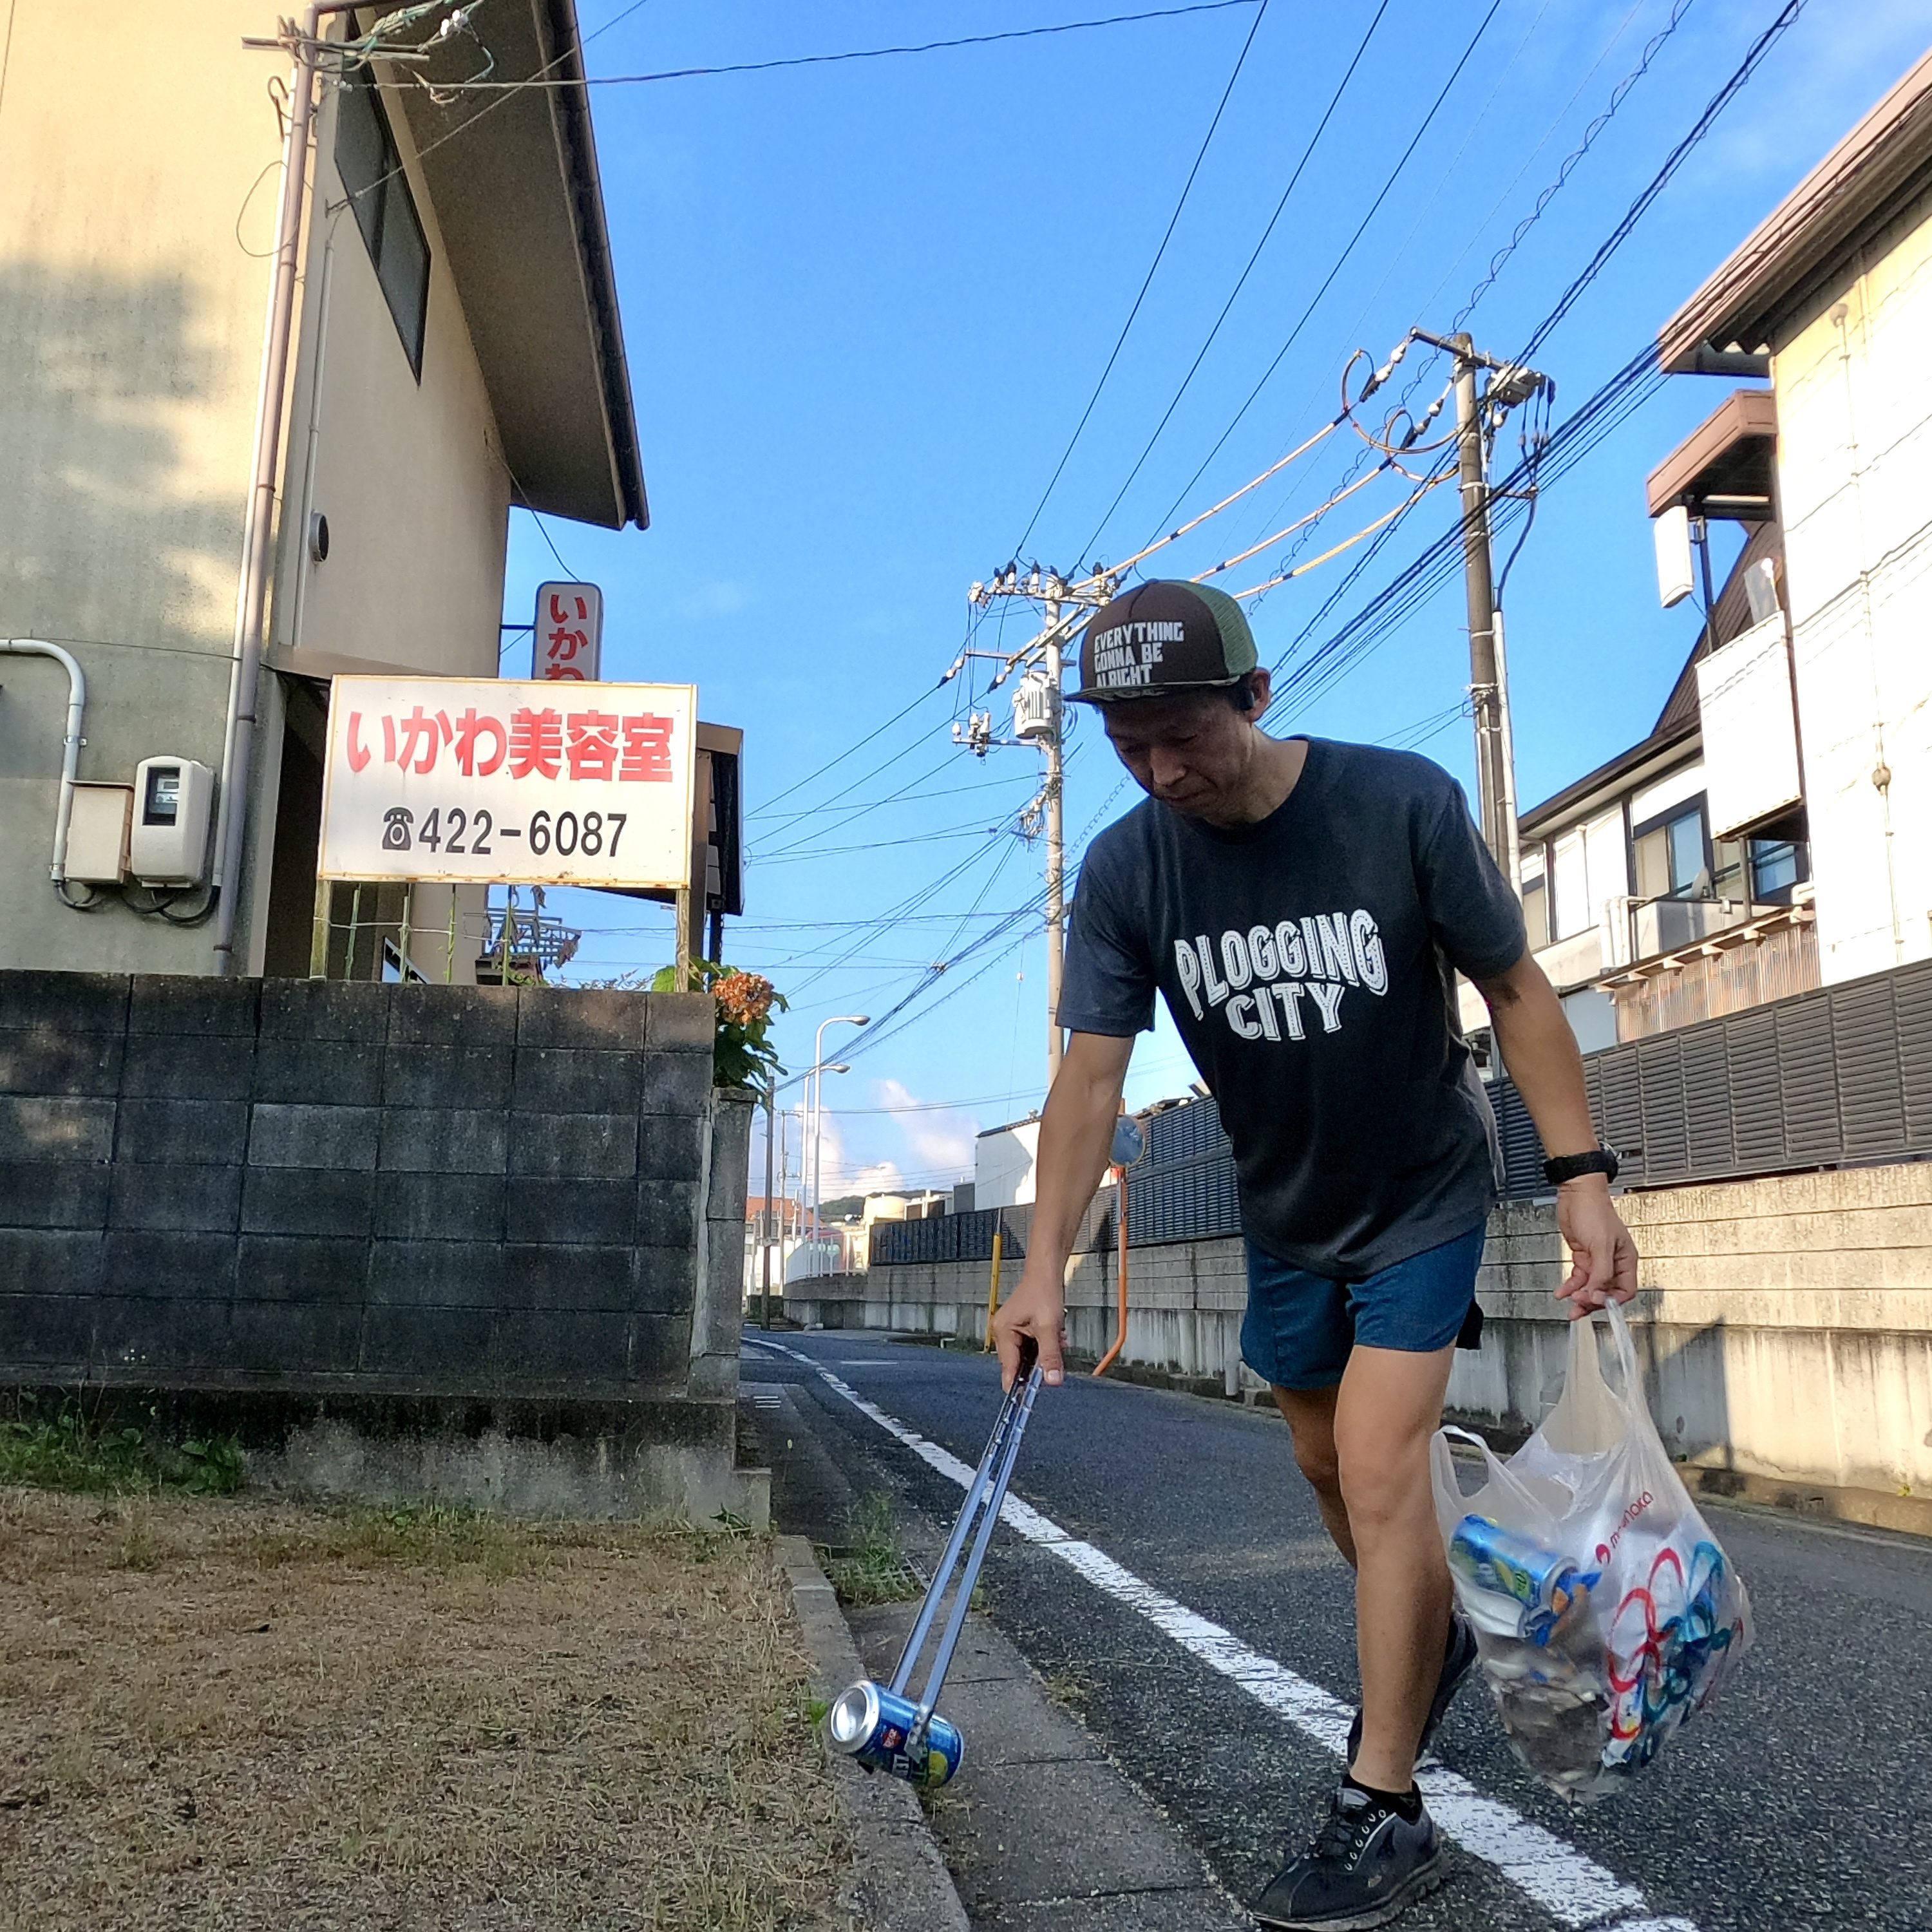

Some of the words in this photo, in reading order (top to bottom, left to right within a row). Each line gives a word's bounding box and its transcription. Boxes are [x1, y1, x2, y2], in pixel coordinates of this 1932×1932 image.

[1095, 621, 1184, 654] EVERYTHING
[1095, 644, 1135, 673] GONNA
[1141, 642, 1163, 664] BE
[346, 705, 674, 782] いかわ美容室
[418, 807, 628, 858] 422-6087
[1174, 909, 1388, 1021] PLOGGING
[1225, 982, 1345, 1041] CITY
